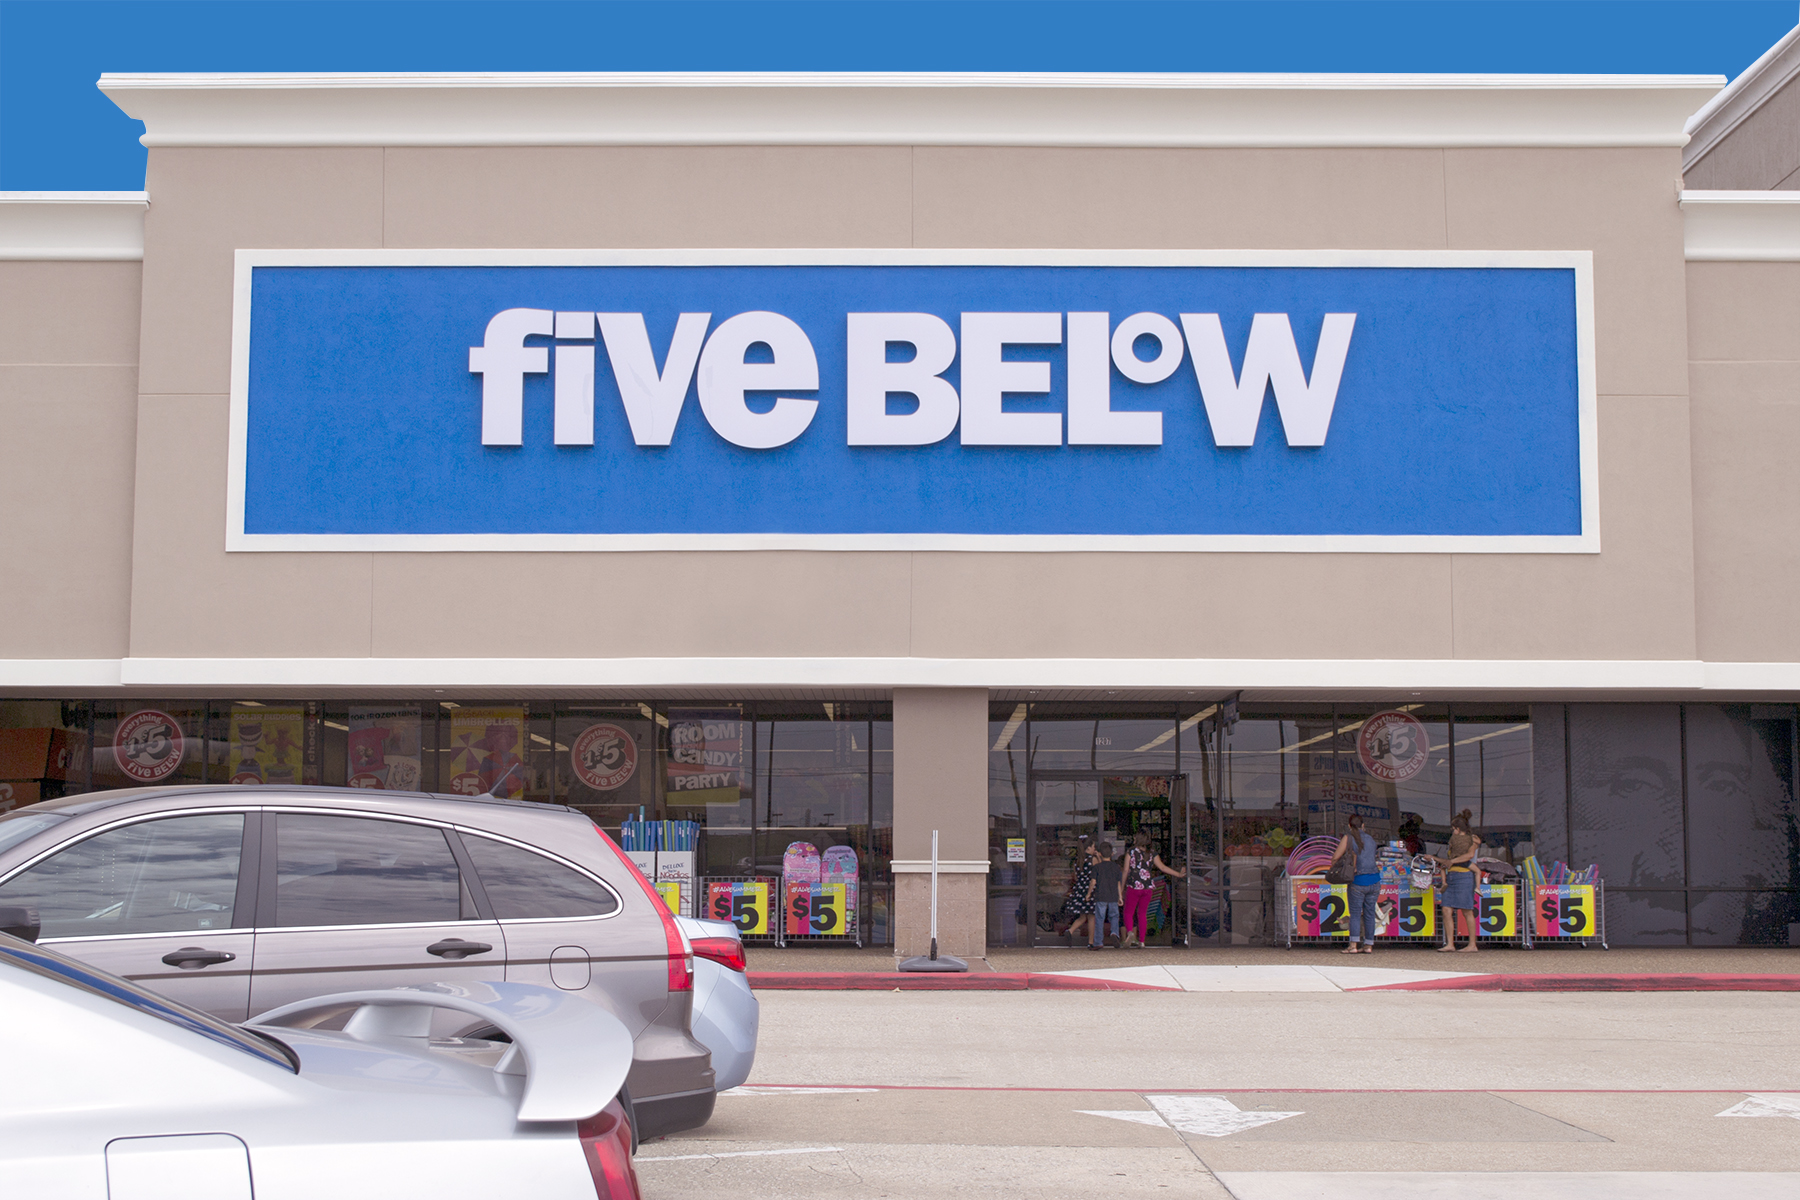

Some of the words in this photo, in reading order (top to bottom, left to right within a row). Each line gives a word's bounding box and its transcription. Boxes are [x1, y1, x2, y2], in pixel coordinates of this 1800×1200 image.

[468, 308, 820, 449] five
[846, 311, 1358, 447] BELOW
[122, 714, 163, 738] everything
[579, 728, 617, 751] everything
[1365, 715, 1406, 739] everything
[127, 762, 152, 777] five
[154, 748, 180, 776] BELOW
[585, 773, 608, 786] five
[608, 759, 634, 784] BELOW
[1372, 763, 1397, 778] five
[1398, 750, 1425, 777] BELOW
[714, 894, 760, 931] $5
[792, 894, 838, 931] $5
[1301, 895, 1350, 933] $2
[1541, 897, 1587, 933] $5
